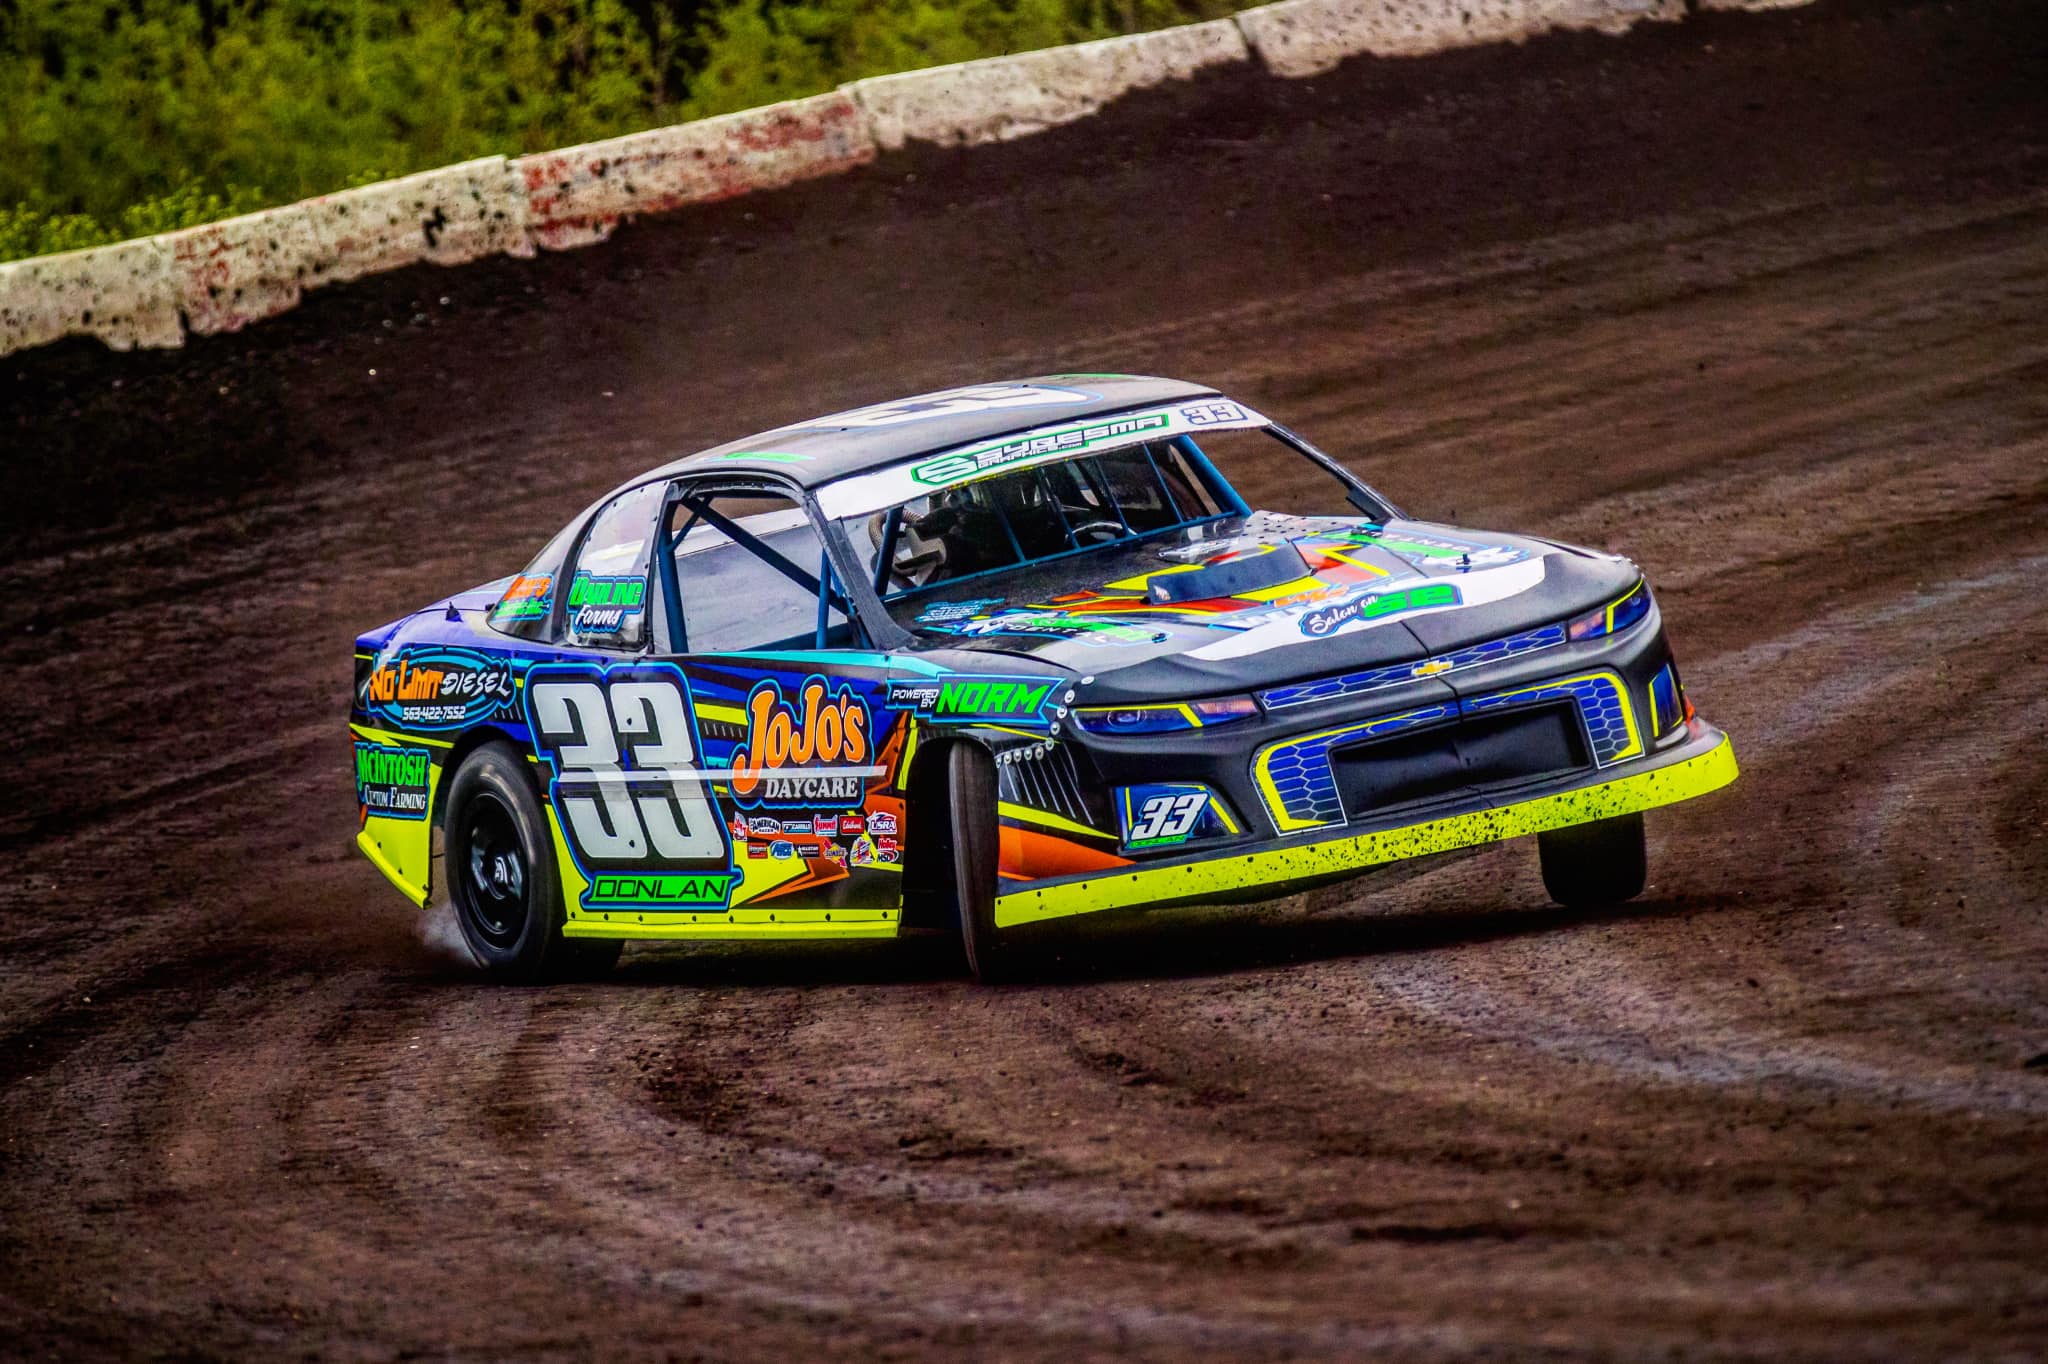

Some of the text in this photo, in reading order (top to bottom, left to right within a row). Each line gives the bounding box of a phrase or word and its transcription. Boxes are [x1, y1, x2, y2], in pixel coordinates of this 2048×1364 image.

[575, 604, 623, 627] Farms
[1309, 603, 1358, 634] Salon
[1360, 593, 1378, 609] on
[369, 665, 396, 701] NO
[440, 671, 511, 697] DIESEL
[892, 688, 939, 700] POWERED
[920, 697, 938, 708] BY
[936, 682, 1050, 714] NORM
[402, 705, 467, 720] 563-422-7552
[533, 682, 725, 858] 33
[389, 786, 427, 810] FARMING
[765, 776, 859, 800] DAYCARE
[871, 820, 896, 831] USRA
[1130, 793, 1208, 841] 33
[594, 878, 730, 900] DONLAN
